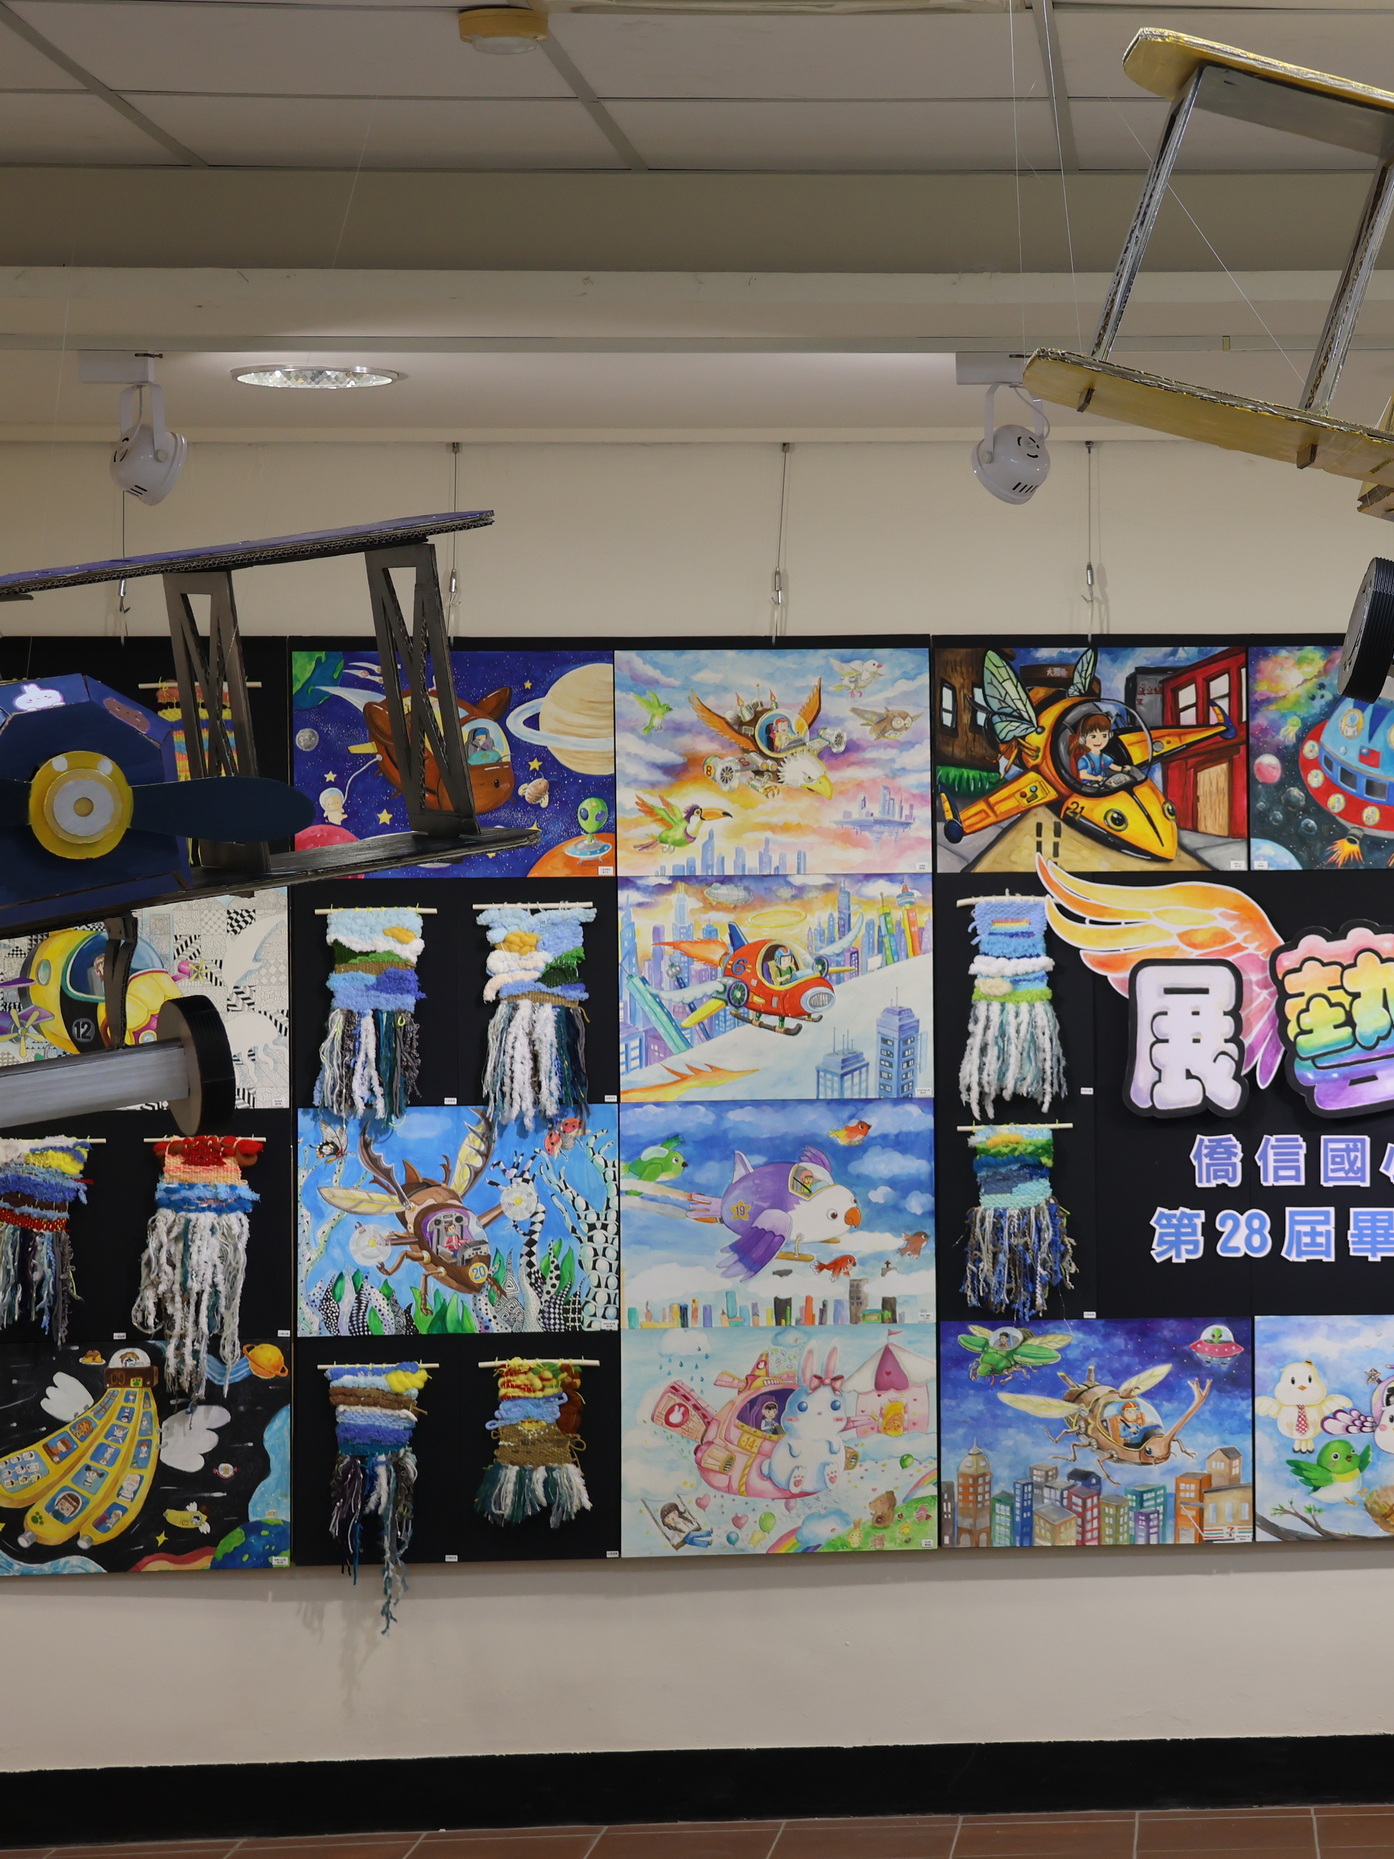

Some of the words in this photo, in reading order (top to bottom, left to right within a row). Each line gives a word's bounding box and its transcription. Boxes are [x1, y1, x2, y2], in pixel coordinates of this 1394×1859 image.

[705, 765, 713, 777] 8
[1066, 801, 1085, 821] 21
[731, 957, 748, 975] 6
[74, 1021, 92, 1040] 12
[735, 1205, 746, 1216] 19
[471, 1265, 487, 1280] 20
[110, 1371, 126, 1385] 09
[744, 1436, 757, 1450] 14
